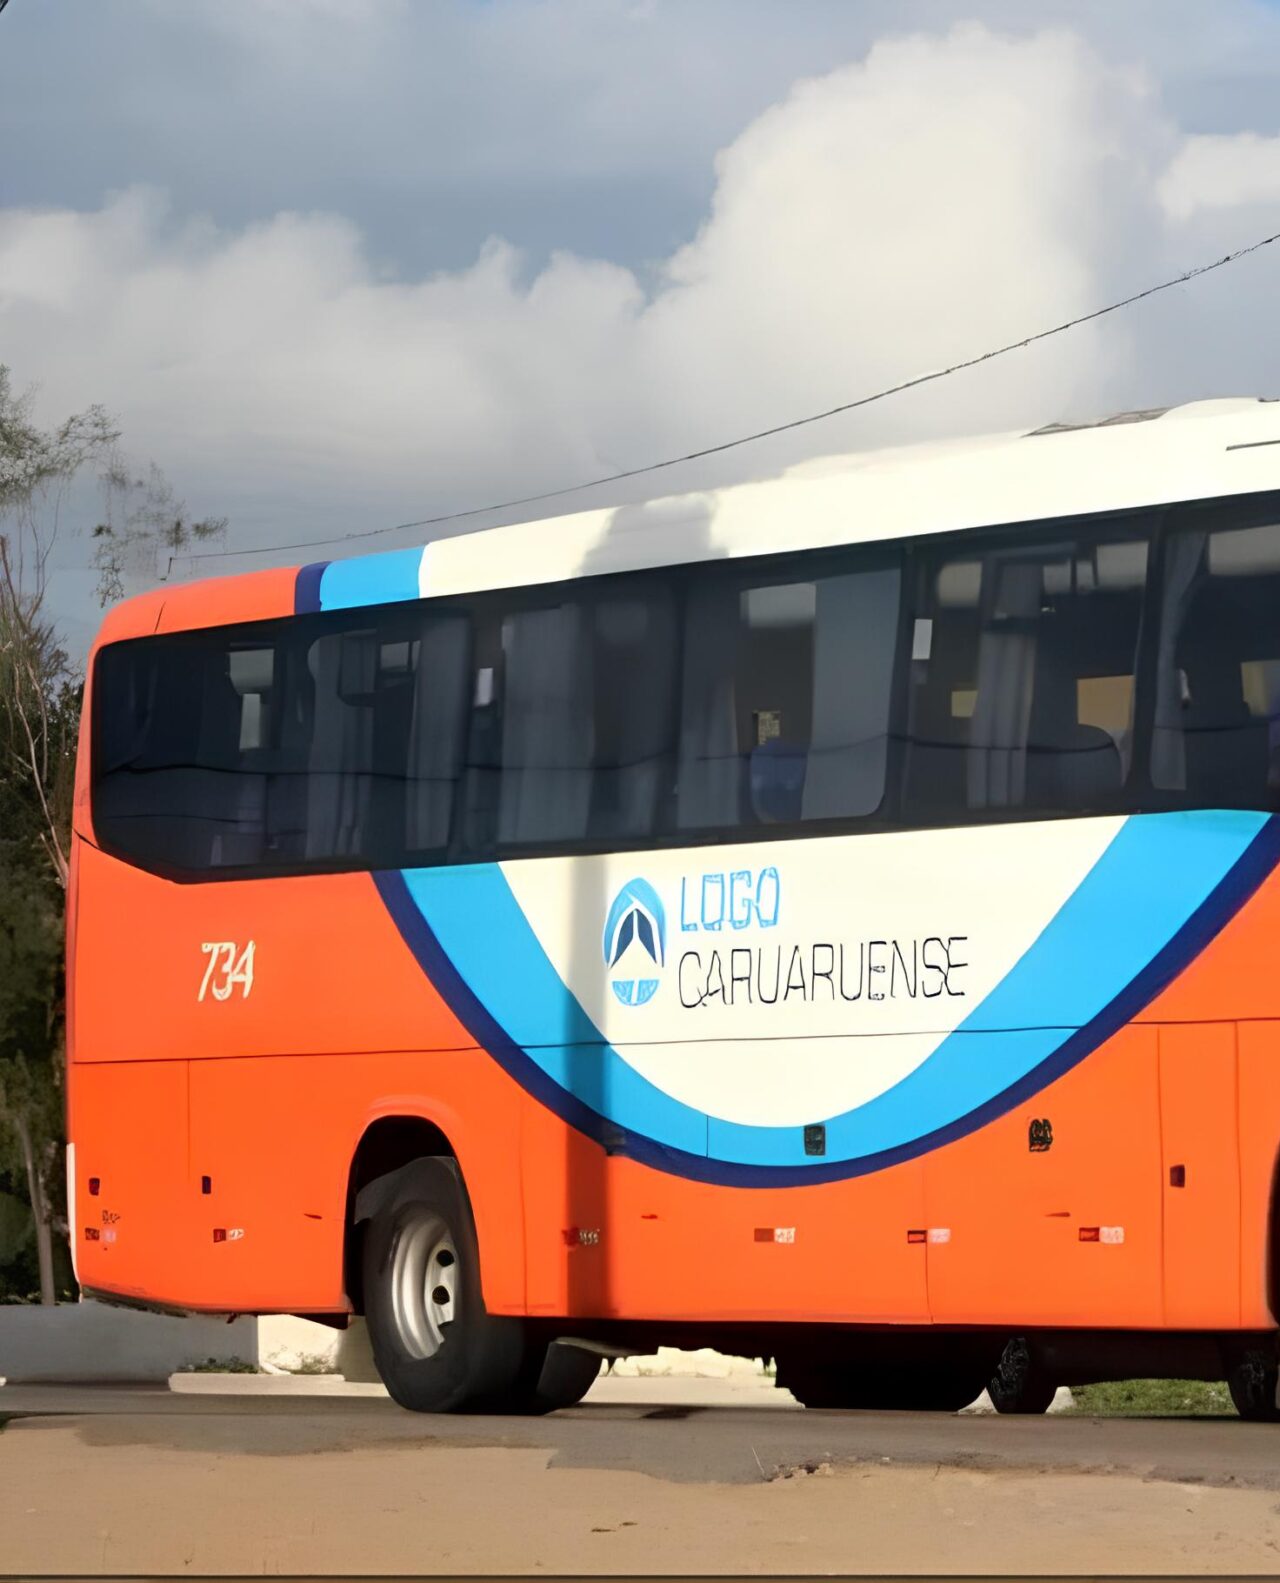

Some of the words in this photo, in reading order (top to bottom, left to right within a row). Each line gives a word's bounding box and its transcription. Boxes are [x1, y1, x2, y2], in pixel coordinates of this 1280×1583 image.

[680, 866, 780, 932] LOGO
[197, 939, 257, 1003] 734
[678, 936, 969, 1009] CARUARUENSE
